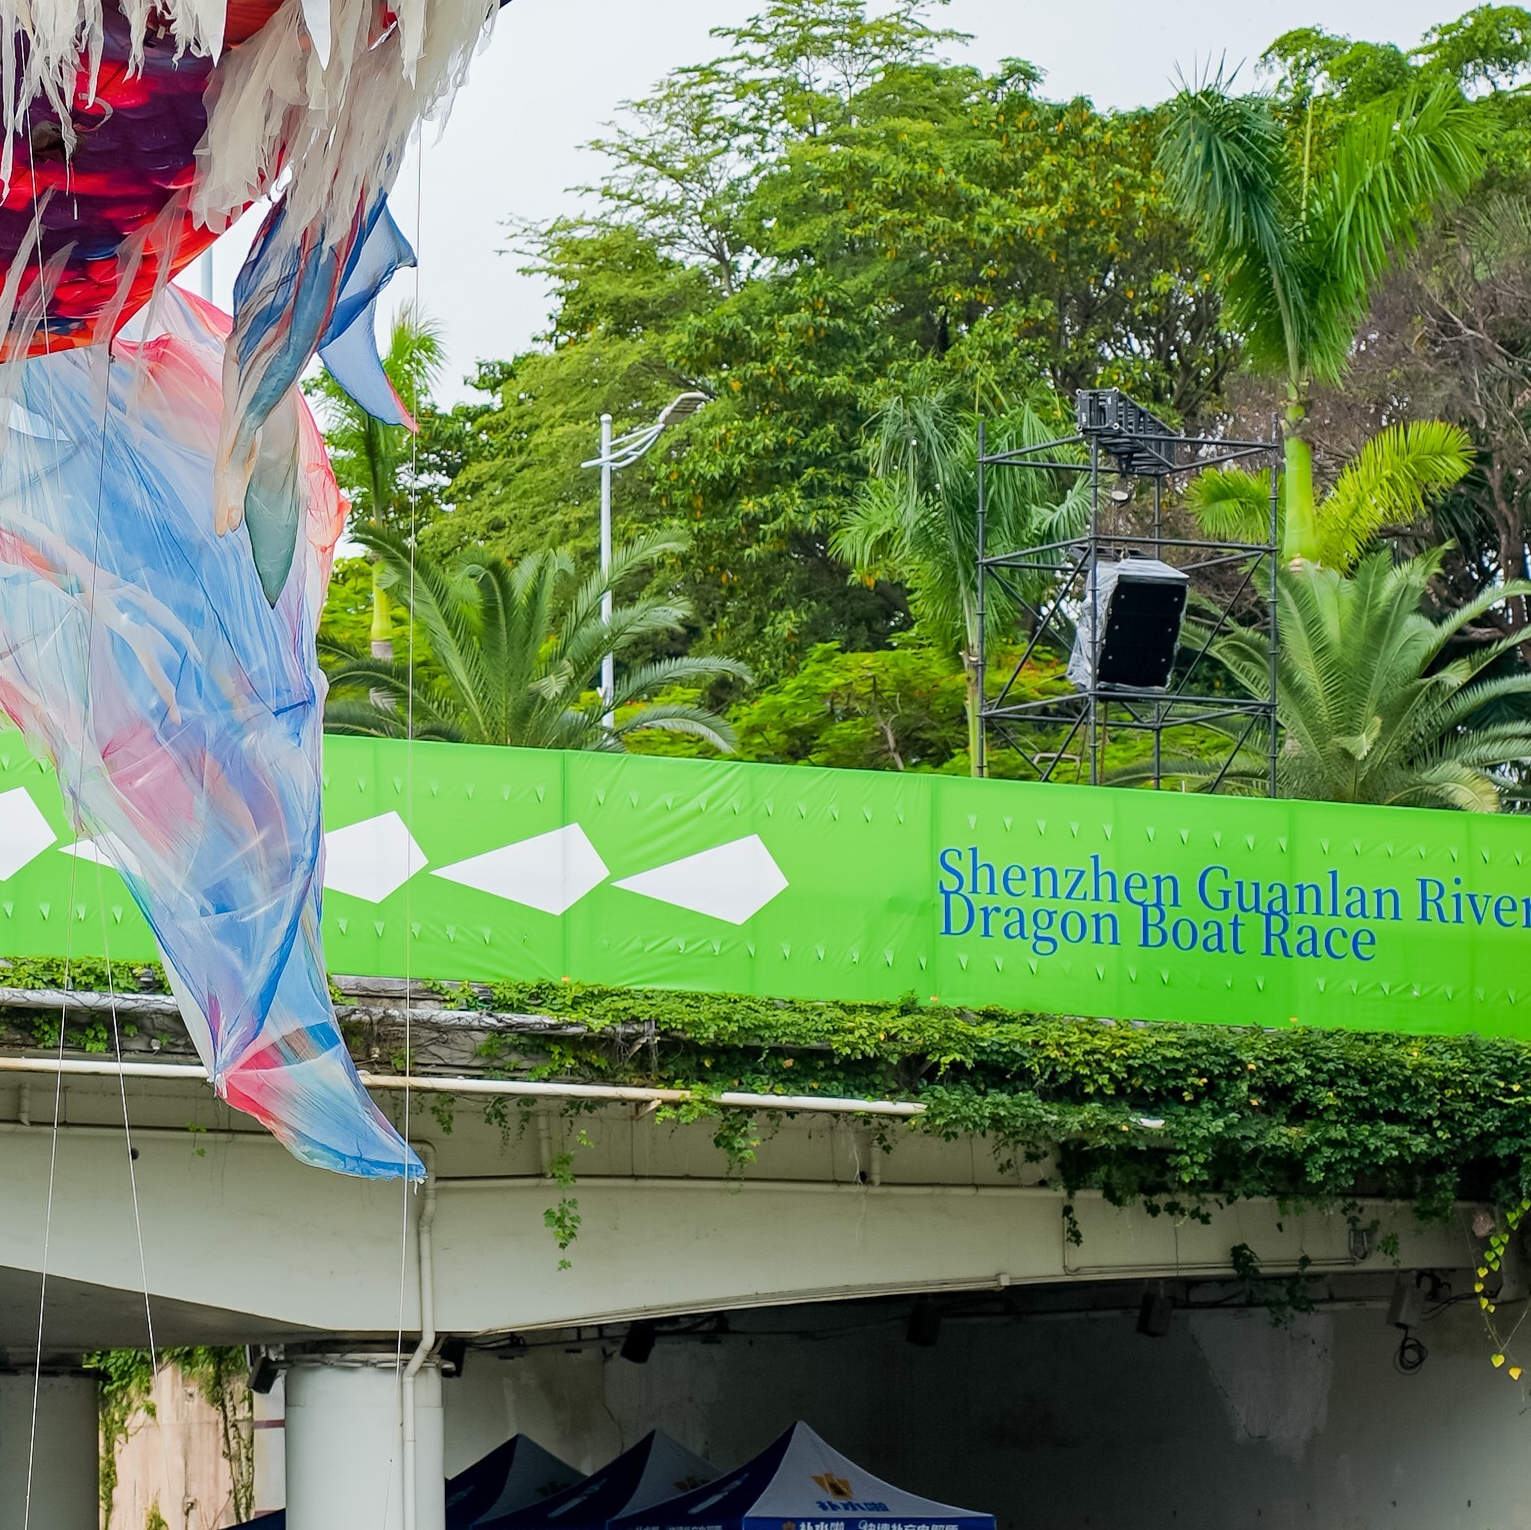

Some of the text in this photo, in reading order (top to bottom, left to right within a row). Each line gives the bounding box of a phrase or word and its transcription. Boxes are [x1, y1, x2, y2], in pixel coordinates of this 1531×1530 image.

[938, 846, 1182, 908] Shenzhen
[1197, 865, 1403, 921] Guanlan
[939, 890, 1378, 961] Dragon Boat Race
